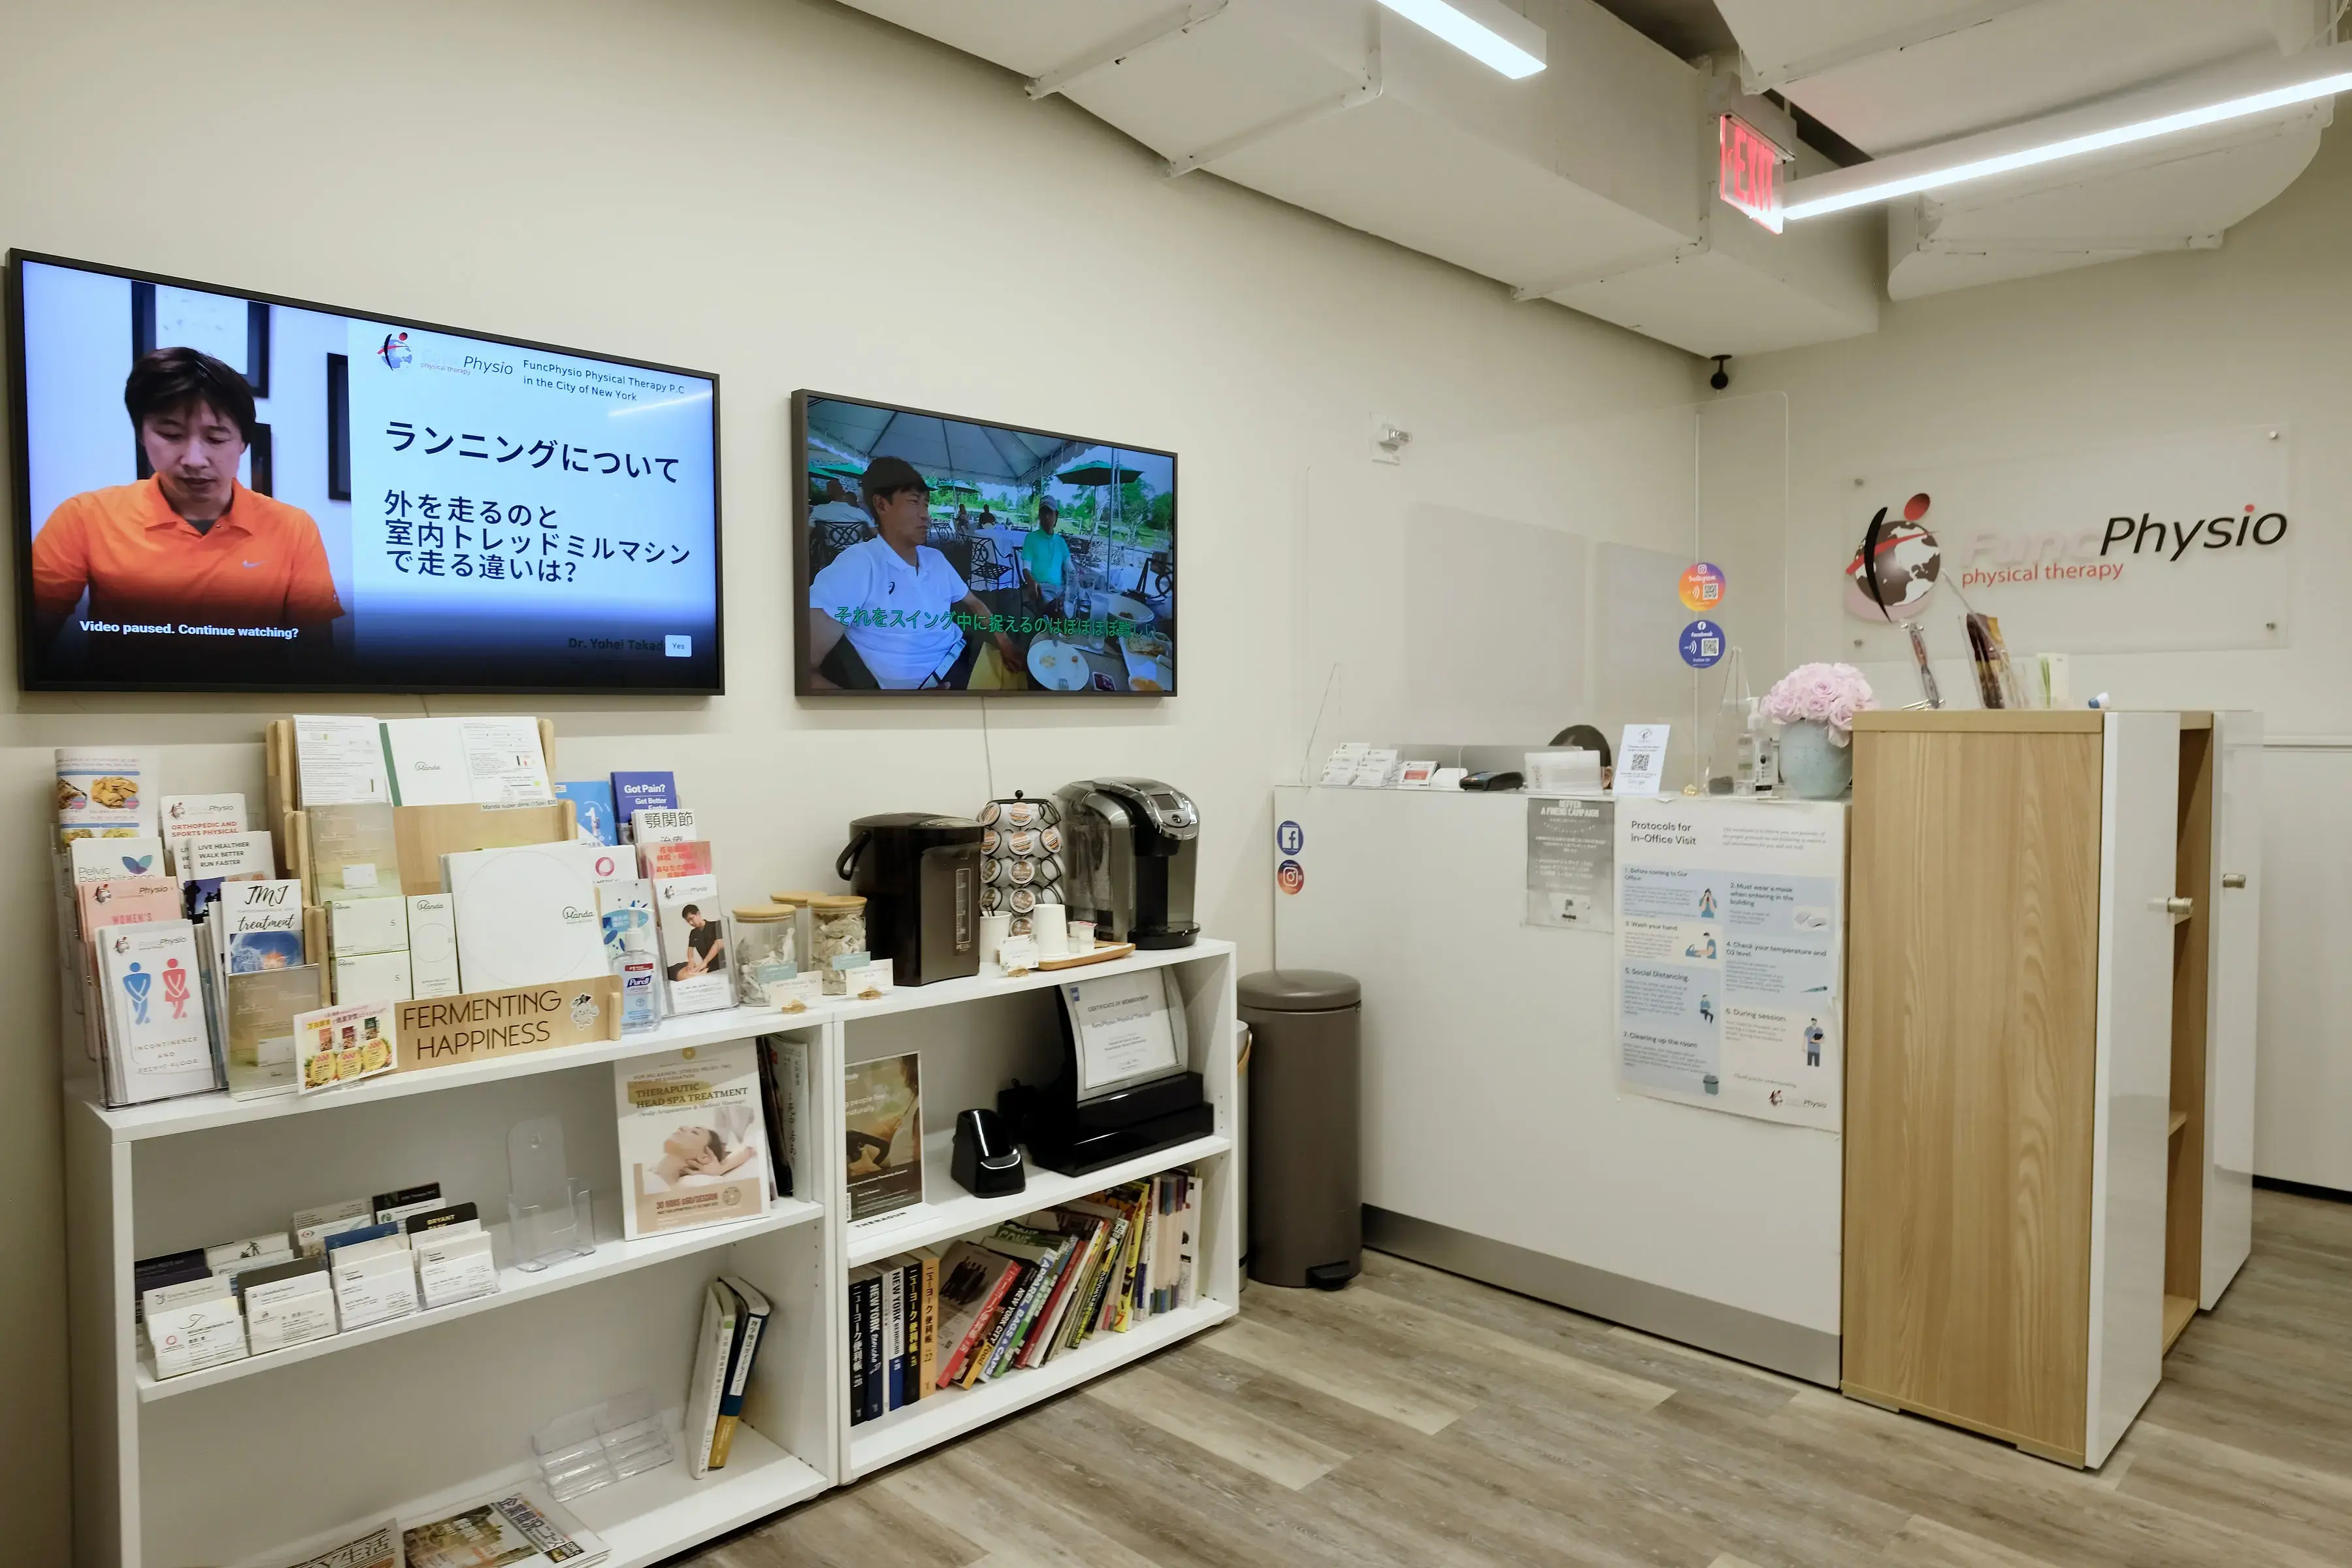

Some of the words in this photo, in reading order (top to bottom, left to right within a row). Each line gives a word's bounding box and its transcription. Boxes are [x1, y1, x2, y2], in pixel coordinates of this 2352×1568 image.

[1733, 125, 1775, 212] EXIT
[421, 362, 446, 371] physical
[448, 366, 471, 376] therapy
[463, 355, 513, 374] Physio
[523, 360, 582, 377] FuncPhysio
[585, 370, 625, 384] Physical
[629, 377, 666, 392] Therapy
[523, 376, 533, 385] in
[536, 378, 553, 388] the
[557, 381, 576, 393] City
[592, 387, 612, 397] New
[615, 391, 637, 401] York
[385, 421, 679, 483] ランニングについて
[384, 489, 558, 529] 外を走るのと
[385, 517, 691, 566] 室内トレッドミルマシン
[2099, 504, 2288, 562] Physio
[386, 547, 577, 582] で走る違いは?
[1962, 564, 2038, 589] physical
[2045, 562, 2124, 581] therapy
[80, 621, 120, 632] Video
[123, 623, 175, 634] paused.
[178, 625, 235, 636] Continue
[238, 627, 299, 640] watching?
[568, 638, 588, 648] Dr.
[590, 638, 624, 649] Yohei
[628, 640, 665, 651] Takad
[624, 785, 641, 794] Got
[642, 784, 666, 793] Pain?
[645, 811, 693, 828] 顎関節
[1631, 821, 1676, 831] Protocols
[1678, 822, 1691, 832] for
[1631, 833, 1673, 844] in-Office
[1675, 836, 1697, 845] Visit
[78, 867, 110, 875] Pelvic
[139, 887, 168, 895] Physio
[244, 885, 289, 907] TMJ
[112, 913, 152, 924] WOMEN'S
[237, 914, 295, 931] treatment
[159, 937, 187, 945] Physio
[1632, 968, 1651, 977] Social
[404, 990, 561, 1030] FERMENTING
[1733, 1009, 1757, 1020] During
[417, 1021, 550, 1060] HAPPINESS
[1629, 1032, 1657, 1043] Cleaning
[636, 1083, 700, 1098] THERAPUTIC
[636, 1098, 665, 1109] HEAD
[667, 1095, 685, 1105] SPA
[688, 1087, 748, 1102] TREATMENT
[427, 1214, 455, 1226] BRYANT
[854, 1212, 907, 1228] THERAGUN
[892, 1271, 900, 1294] NEW
[1011, 1287, 1026, 1307] NEW
[892, 1295, 900, 1324] YORK
[1002, 1307, 1016, 1325] YORK
[1005, 1309, 1026, 1338] BAGS
[989, 1323, 1005, 1344] CITY
[977, 1344, 992, 1367] Food
[985, 1346, 1004, 1376] CAPS
